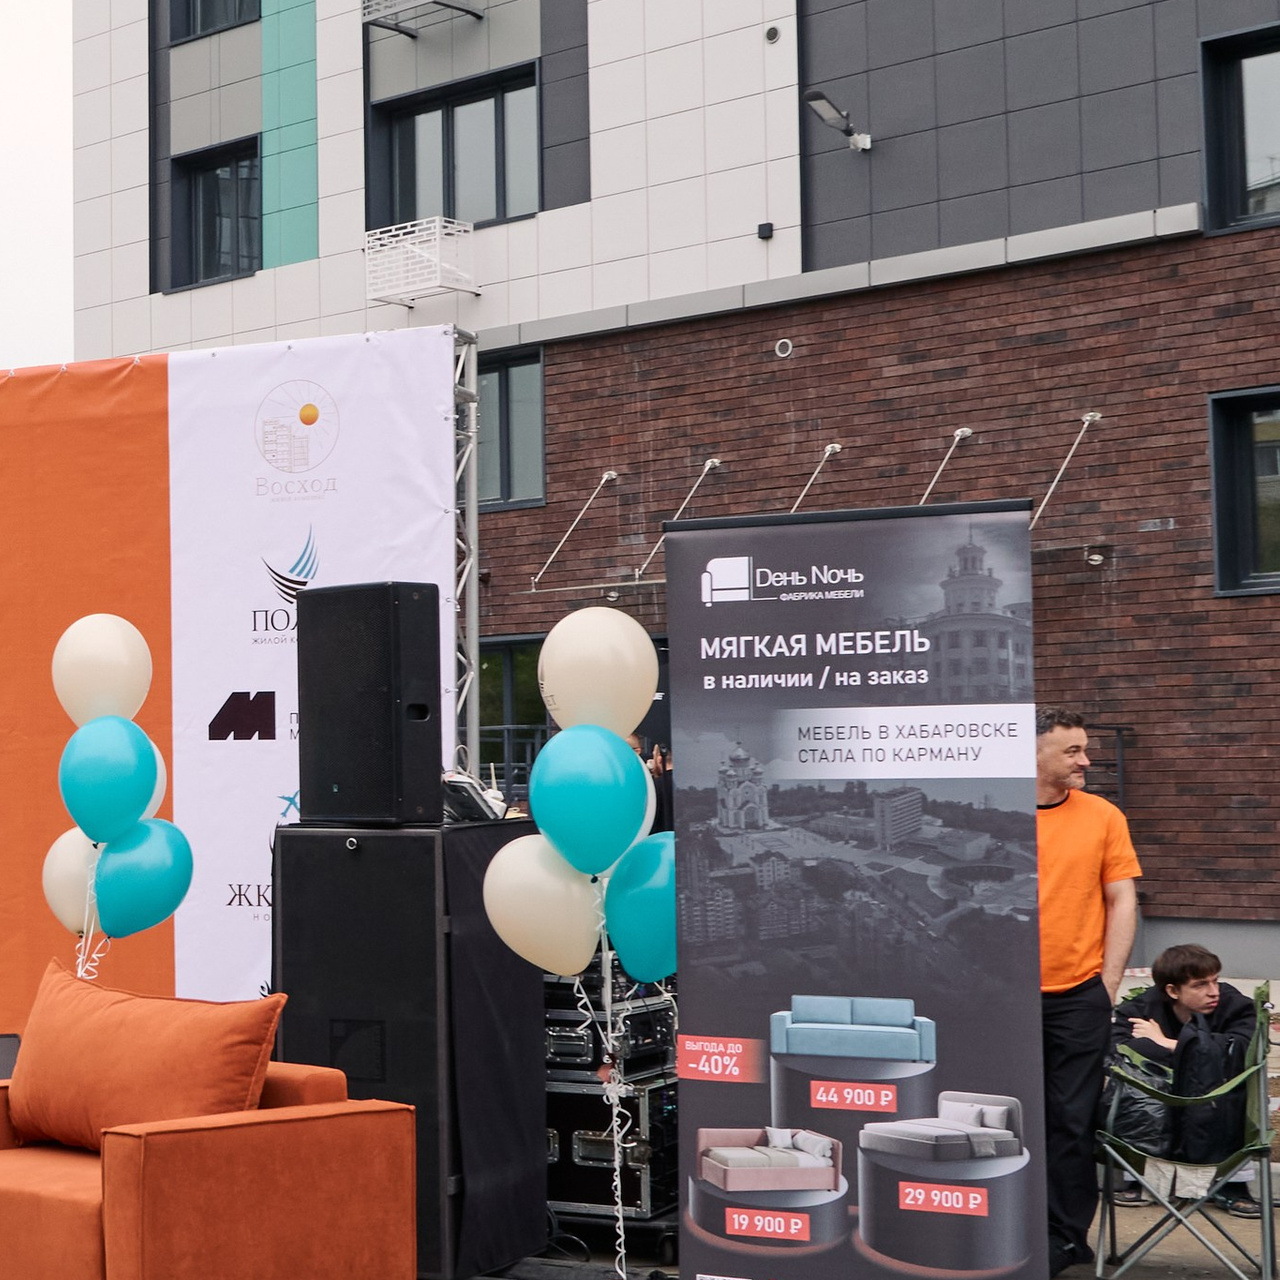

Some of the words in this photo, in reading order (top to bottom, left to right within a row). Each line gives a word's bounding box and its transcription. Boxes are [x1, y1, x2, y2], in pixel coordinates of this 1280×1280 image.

[255, 477, 338, 496] Восход
[779, 591, 824, 602] ФАБРИКА
[825, 589, 864, 600] МЕБЕЛИ
[251, 635, 287, 645] ЖИЛОЙ
[700, 634, 807, 660] МЯГКАЯ
[815, 629, 931, 656] МЕБЕЛЬ
[721, 672, 814, 689] наличии
[835, 671, 861, 686] на
[867, 669, 929, 686] заказ
[797, 725, 872, 741] МЕБЕЛЬ
[878, 725, 890, 739] В
[895, 722, 1019, 740] ХАБАРОВСКЕ
[797, 748, 857, 763] СТАЛА
[862, 748, 887, 762] ПО
[892, 746, 983, 762] КАРМАНУ
[684, 1040, 725, 1054] ВЫГОДА
[726, 1042, 743, 1055] ДО
[687, 1054, 741, 1076] -40%
[815, 1086, 839, 1104] 44
[843, 1088, 876, 1106] 900
[904, 1187, 926, 1206] 29
[931, 1189, 964, 1209] 900
[731, 1213, 749, 1231] 19
[753, 1215, 786, 1234] 900
